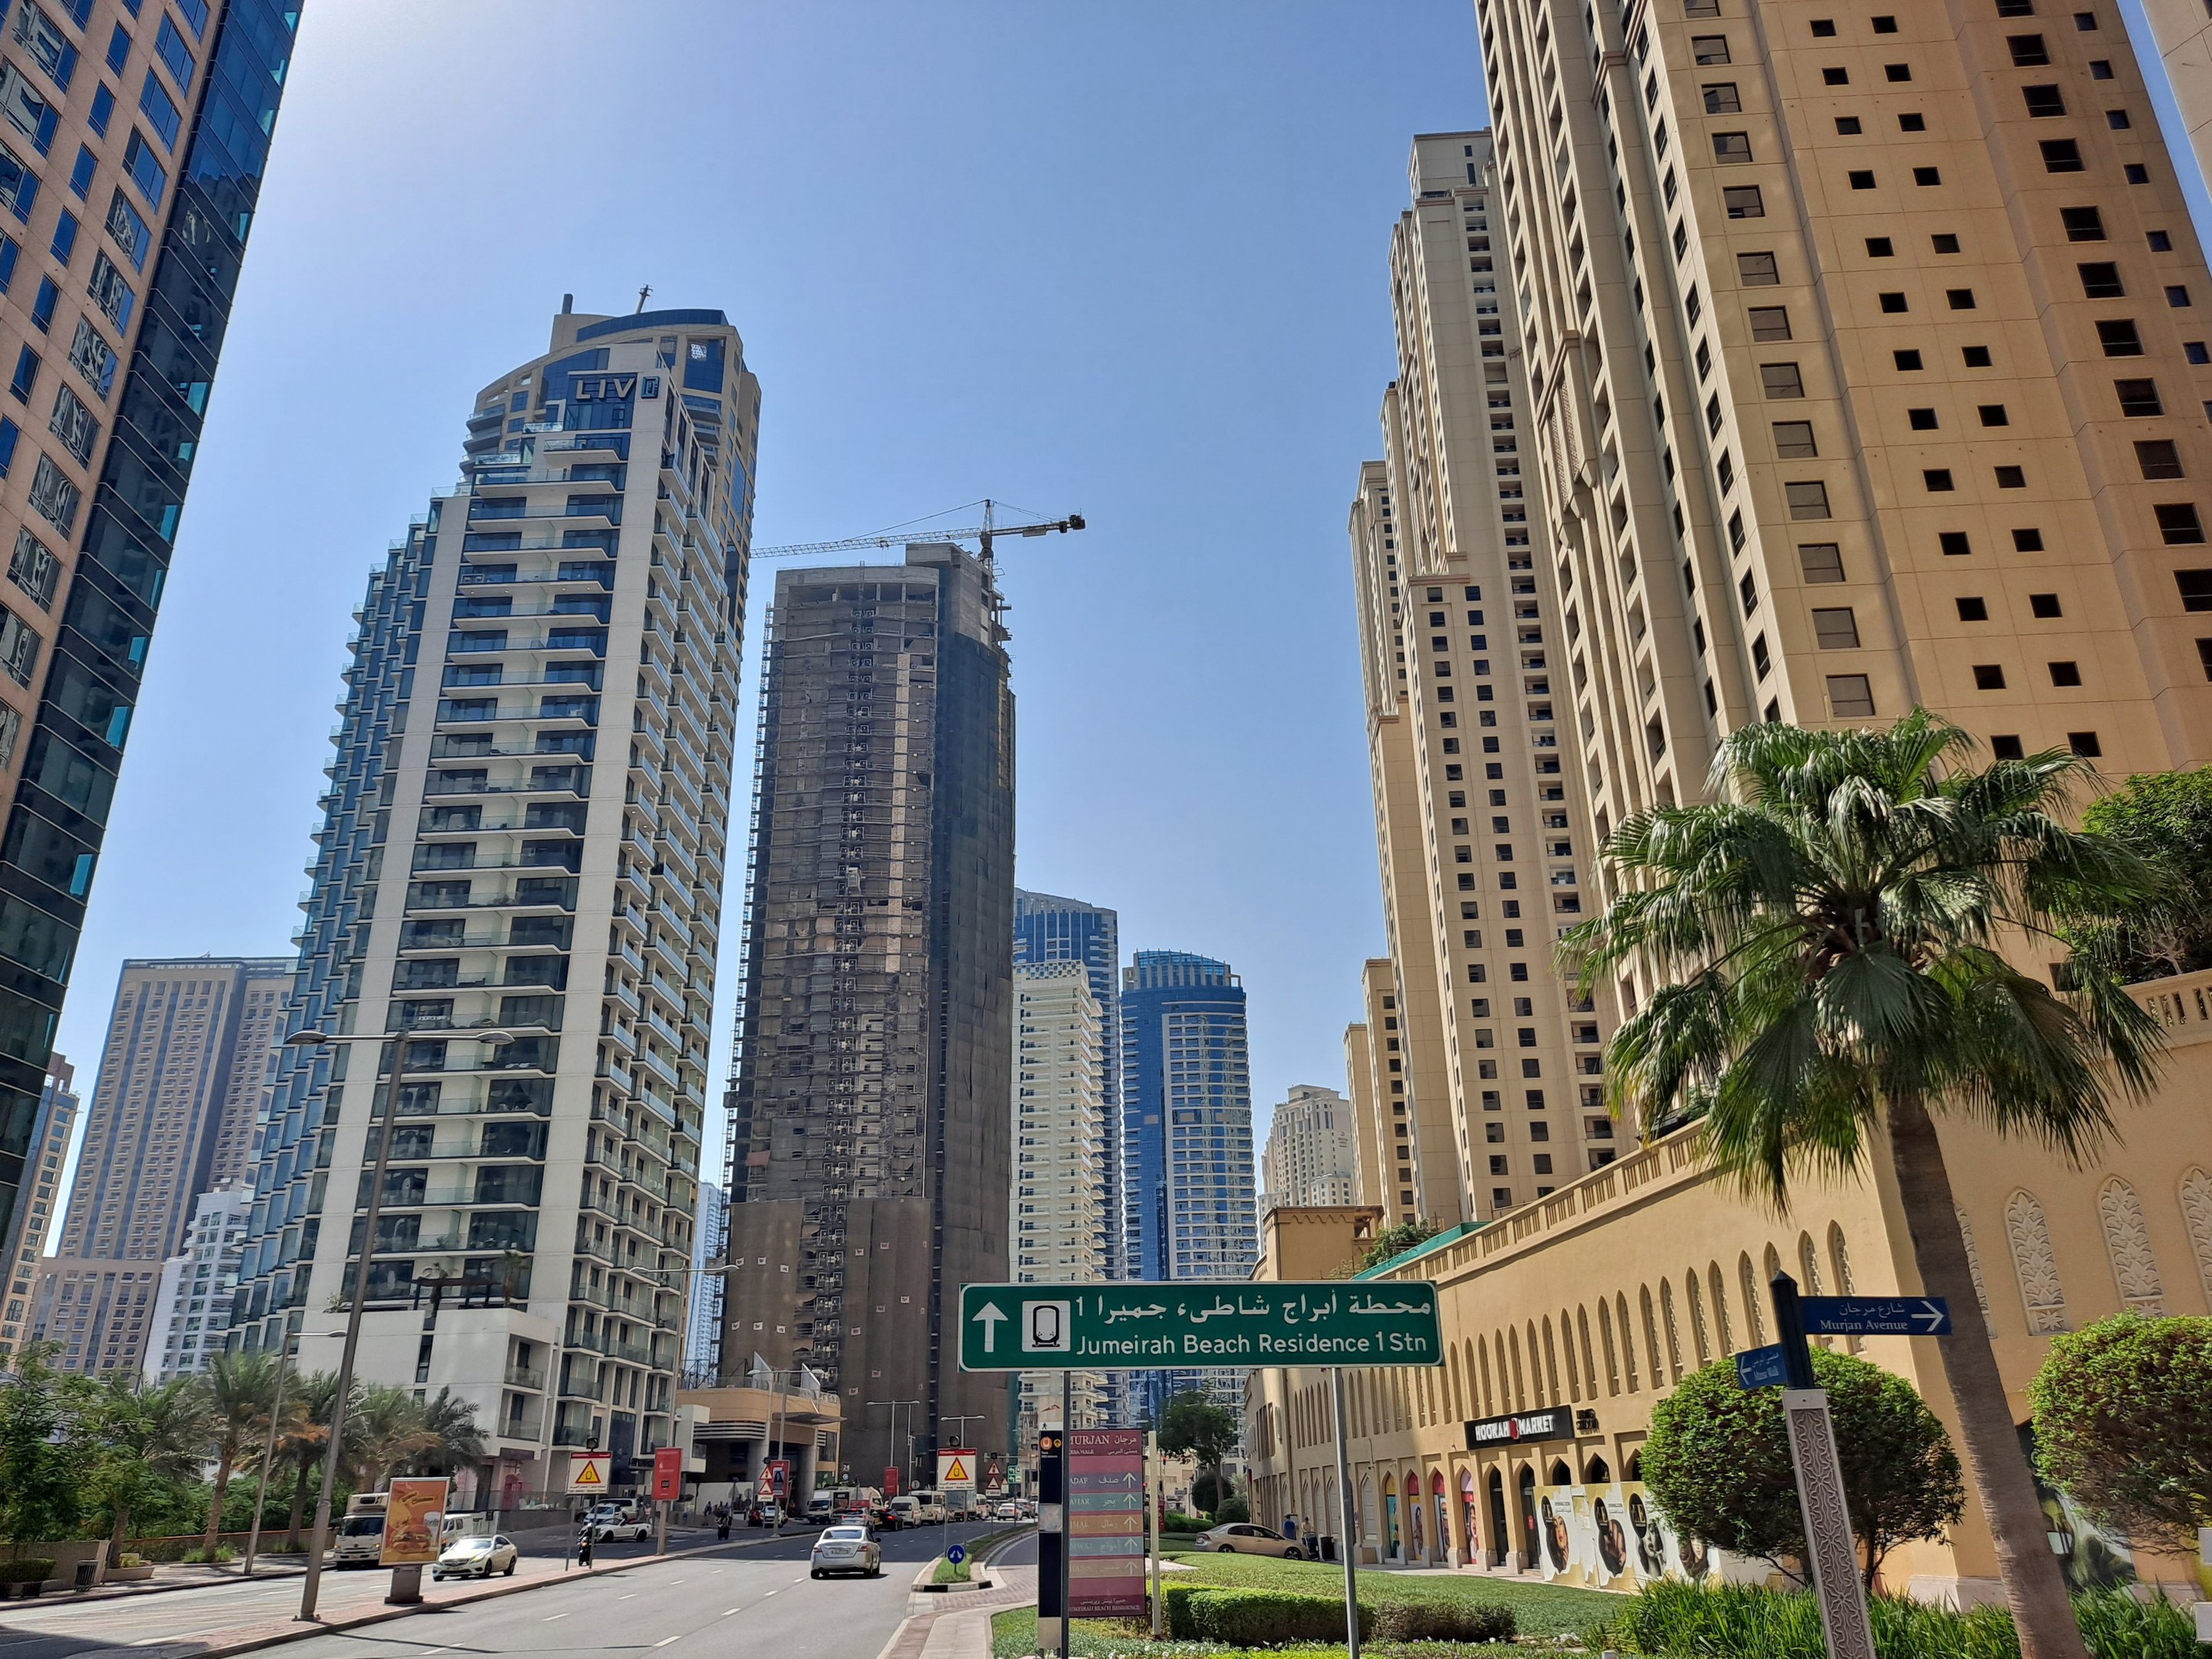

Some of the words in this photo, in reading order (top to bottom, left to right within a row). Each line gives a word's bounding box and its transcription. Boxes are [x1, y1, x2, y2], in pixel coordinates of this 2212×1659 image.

[576, 378, 635, 399] LIV
[1075, 1296, 1083, 1316] 1
[1098, 1294, 1167, 1324] جميرا
[1282, 1288, 1337, 1324] أبراج
[1349, 1293, 1431, 1315] محطة
[1839, 1302, 1876, 1316] مرجان
[1878, 1302, 1905, 1319] شارع
[1820, 1319, 1863, 1333] Murjan
[1866, 1320, 1909, 1330] Avenue
[1076, 1334, 1175, 1355] Jumeirah
[1184, 1333, 1250, 1354] Beach
[1259, 1333, 1370, 1353] Residence
[1376, 1331, 1384, 1352] 1
[1389, 1333, 1427, 1352] Stn
[1475, 1421, 1510, 1441] HOOKAH
[1518, 1415, 1556, 1435] MARKET
[1114, 1434, 1137, 1445] مرجان
